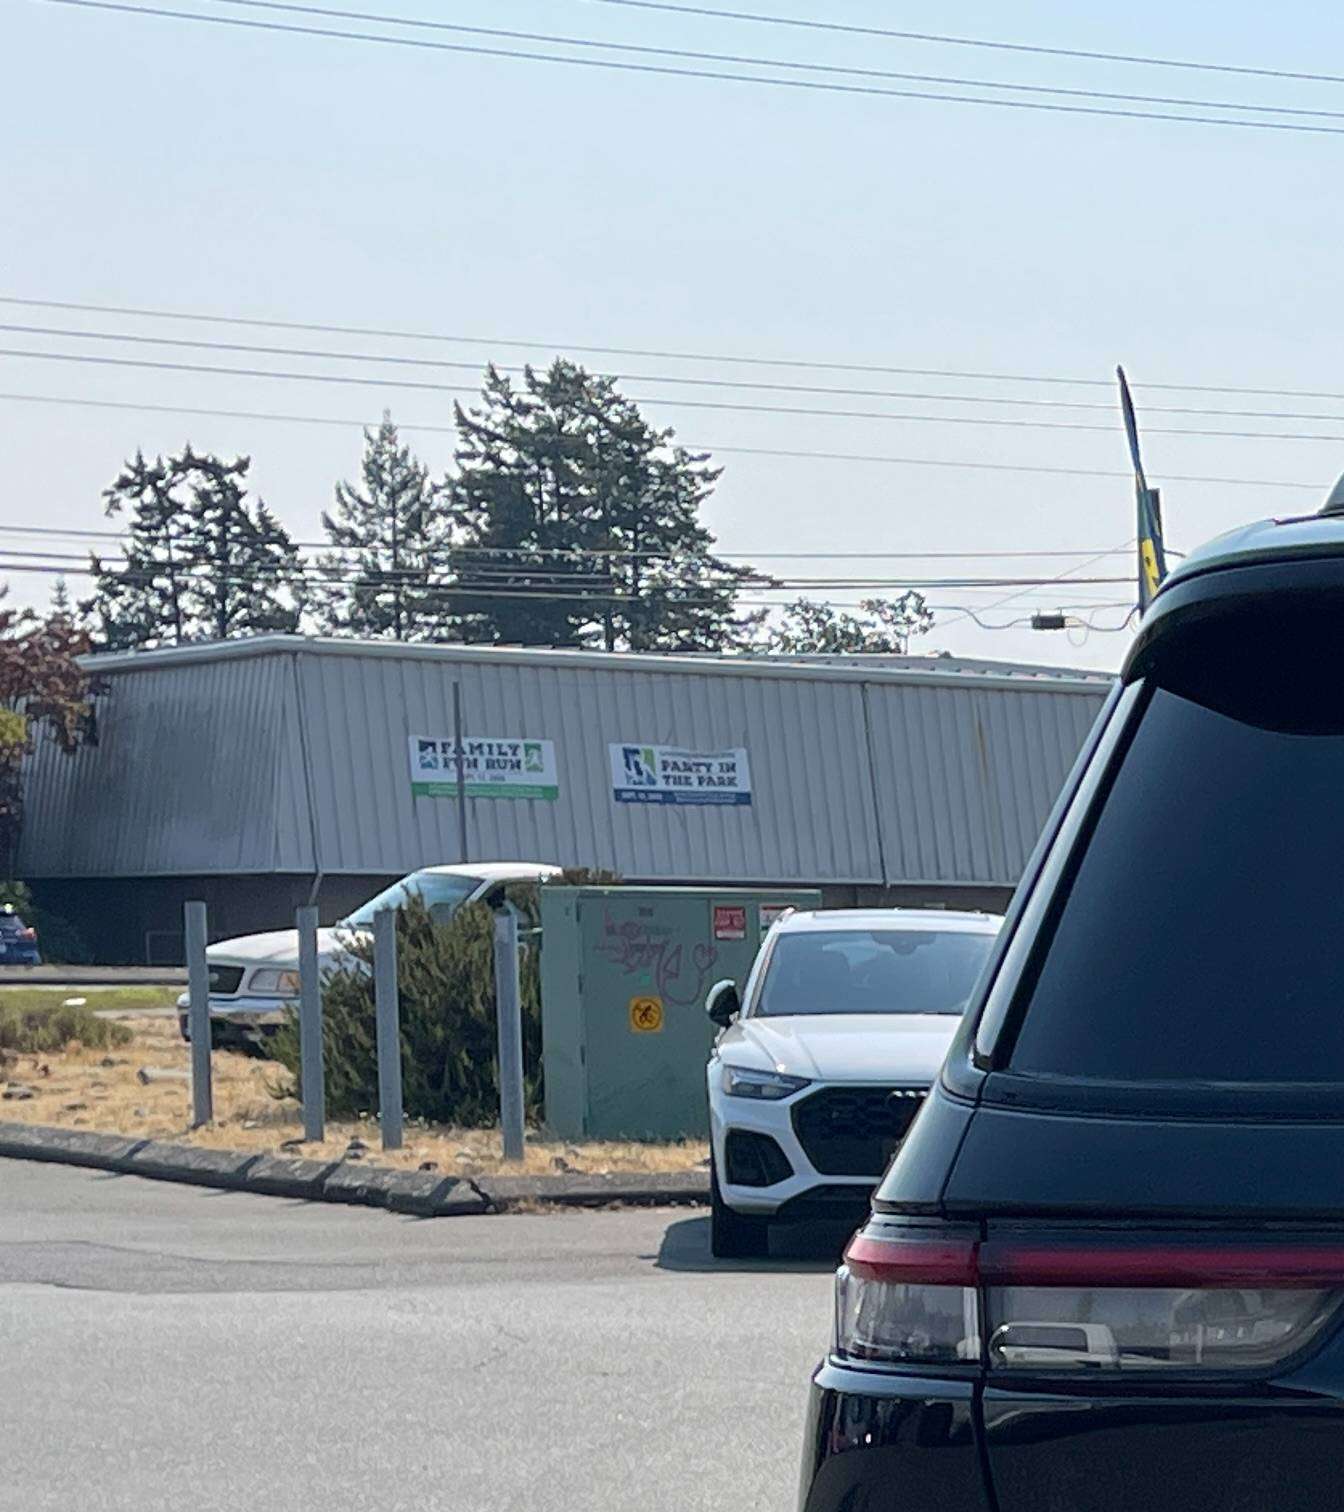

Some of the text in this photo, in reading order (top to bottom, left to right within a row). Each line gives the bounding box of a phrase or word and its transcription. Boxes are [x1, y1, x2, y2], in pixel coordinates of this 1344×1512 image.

[440, 742, 521, 756] FAMILY
[442, 757, 522, 770] FN RUN
[661, 760, 737, 774] PARTY IN
[662, 774, 738, 787] THE PARK
